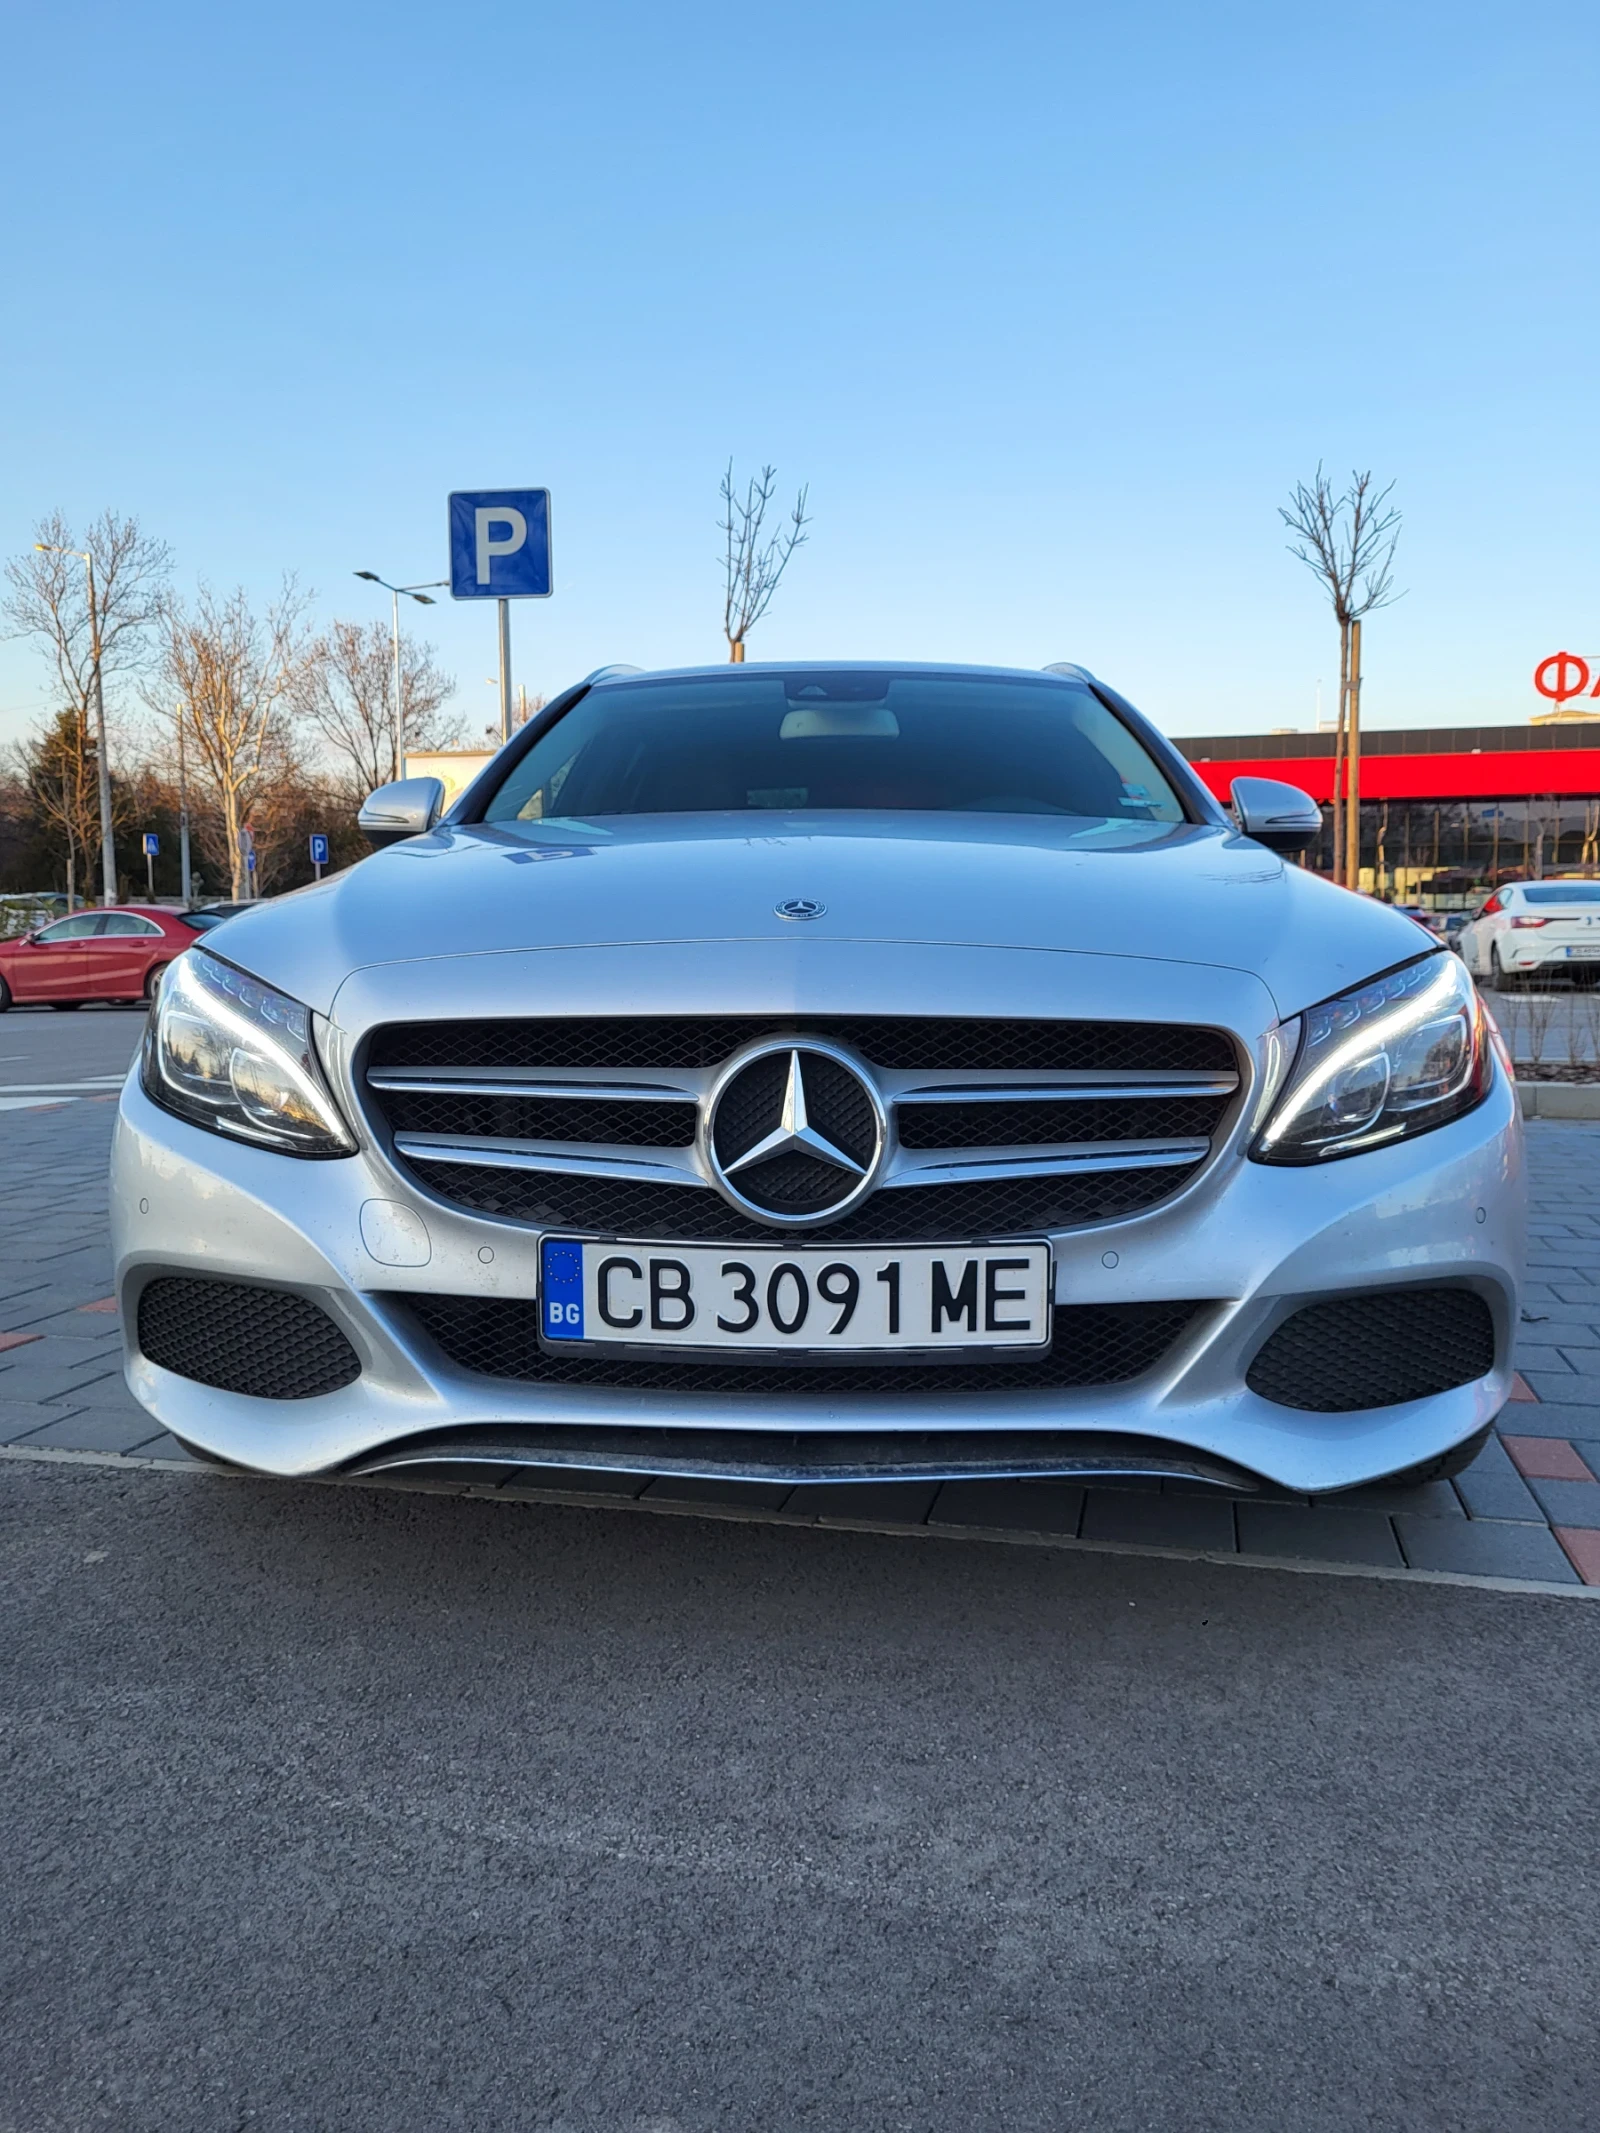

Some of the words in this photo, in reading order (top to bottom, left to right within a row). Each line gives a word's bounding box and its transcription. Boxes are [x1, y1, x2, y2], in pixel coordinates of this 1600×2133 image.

[475, 506, 527, 585] P
[1534, 651, 1600, 702] Ф
[314, 839, 325, 860] P
[549, 1302, 580, 1324] BG
[597, 1256, 695, 1330] CB
[717, 1262, 900, 1335] 3091
[931, 1259, 1031, 1333] ME
